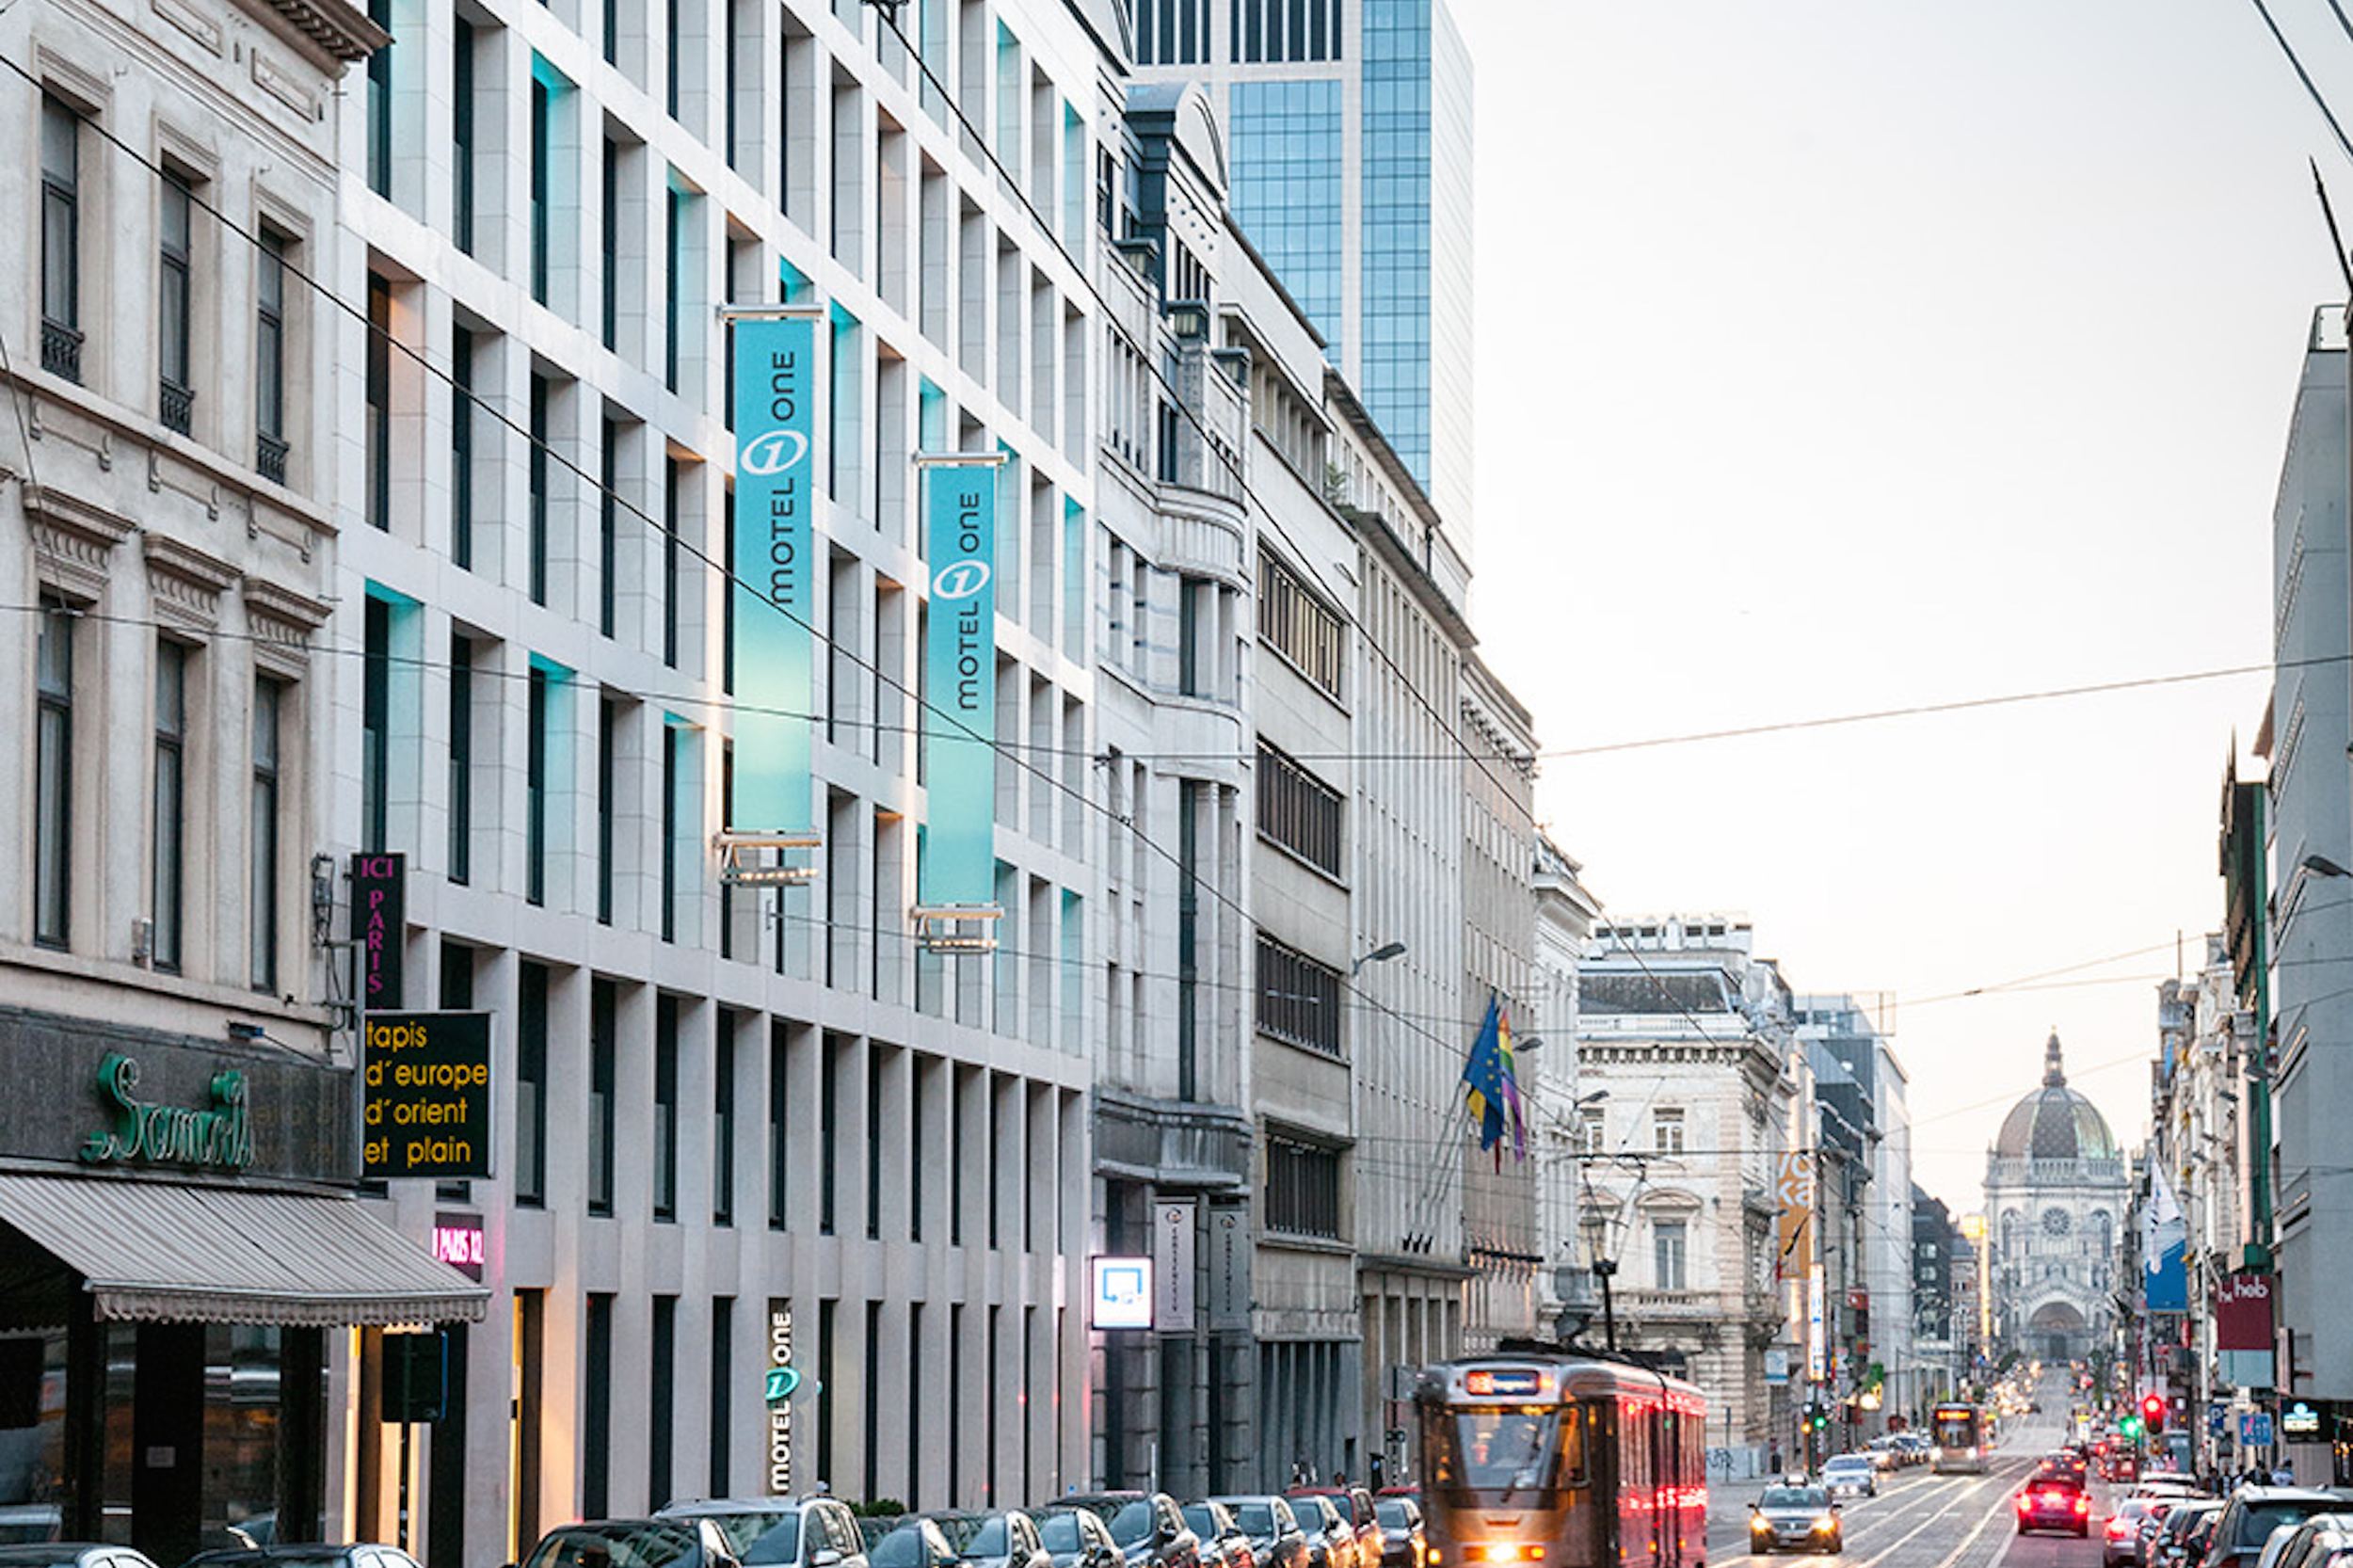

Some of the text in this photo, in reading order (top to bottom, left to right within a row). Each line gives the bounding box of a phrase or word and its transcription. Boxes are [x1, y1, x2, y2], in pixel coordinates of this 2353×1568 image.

[771, 350, 794, 422] ONE
[771, 477, 794, 605] MOTEL
[959, 492, 980, 553] ONE
[958, 600, 980, 710] MOTEL
[360, 856, 393, 879] ICI
[367, 889, 385, 995] PARIS
[365, 1020, 428, 1053] tapis
[363, 1135, 472, 1169] et plain
[771, 1311, 792, 1365] ONE
[771, 1400, 792, 1492] MOTEL
